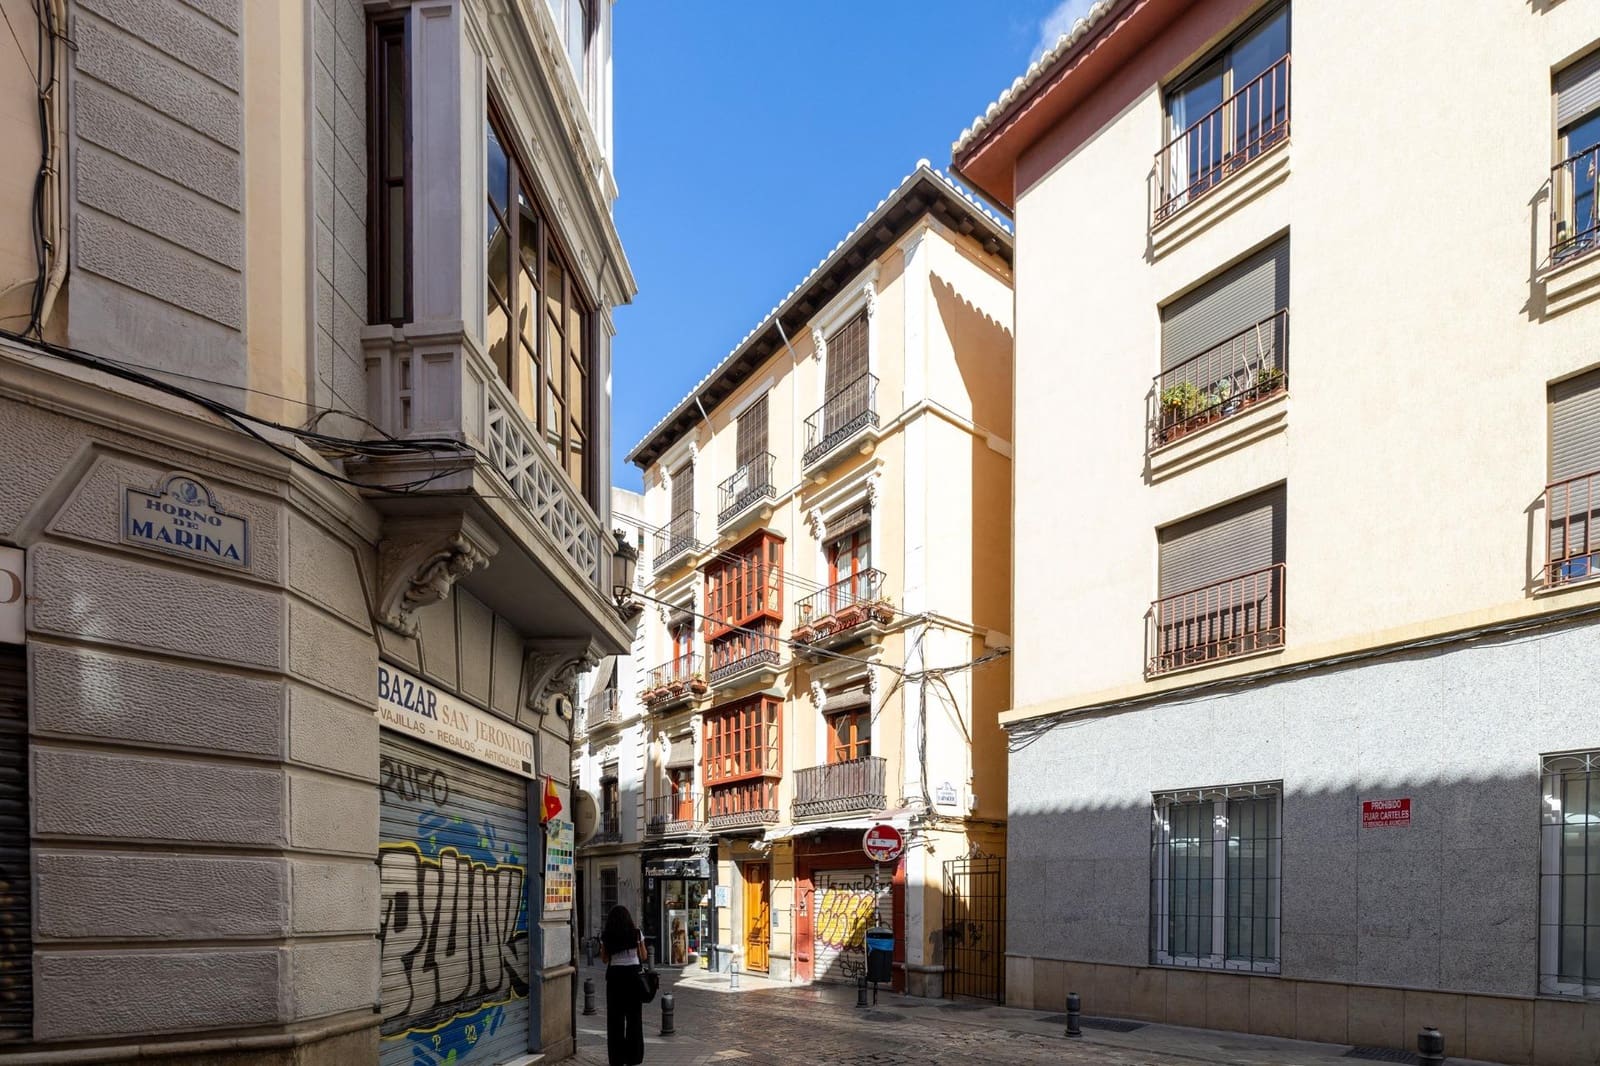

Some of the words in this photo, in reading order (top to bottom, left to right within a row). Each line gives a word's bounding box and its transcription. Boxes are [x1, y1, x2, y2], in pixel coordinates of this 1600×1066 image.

[146, 499, 222, 527] HORNO
[173, 518, 199, 530] DE
[132, 519, 241, 561] MARINA
[378, 666, 438, 721] BAZAR
[442, 704, 469, 733] SAN
[380, 706, 426, 735] VAJILLAS
[437, 729, 476, 753] REGALOS
[1380, 810, 1410, 820] CARTELES
